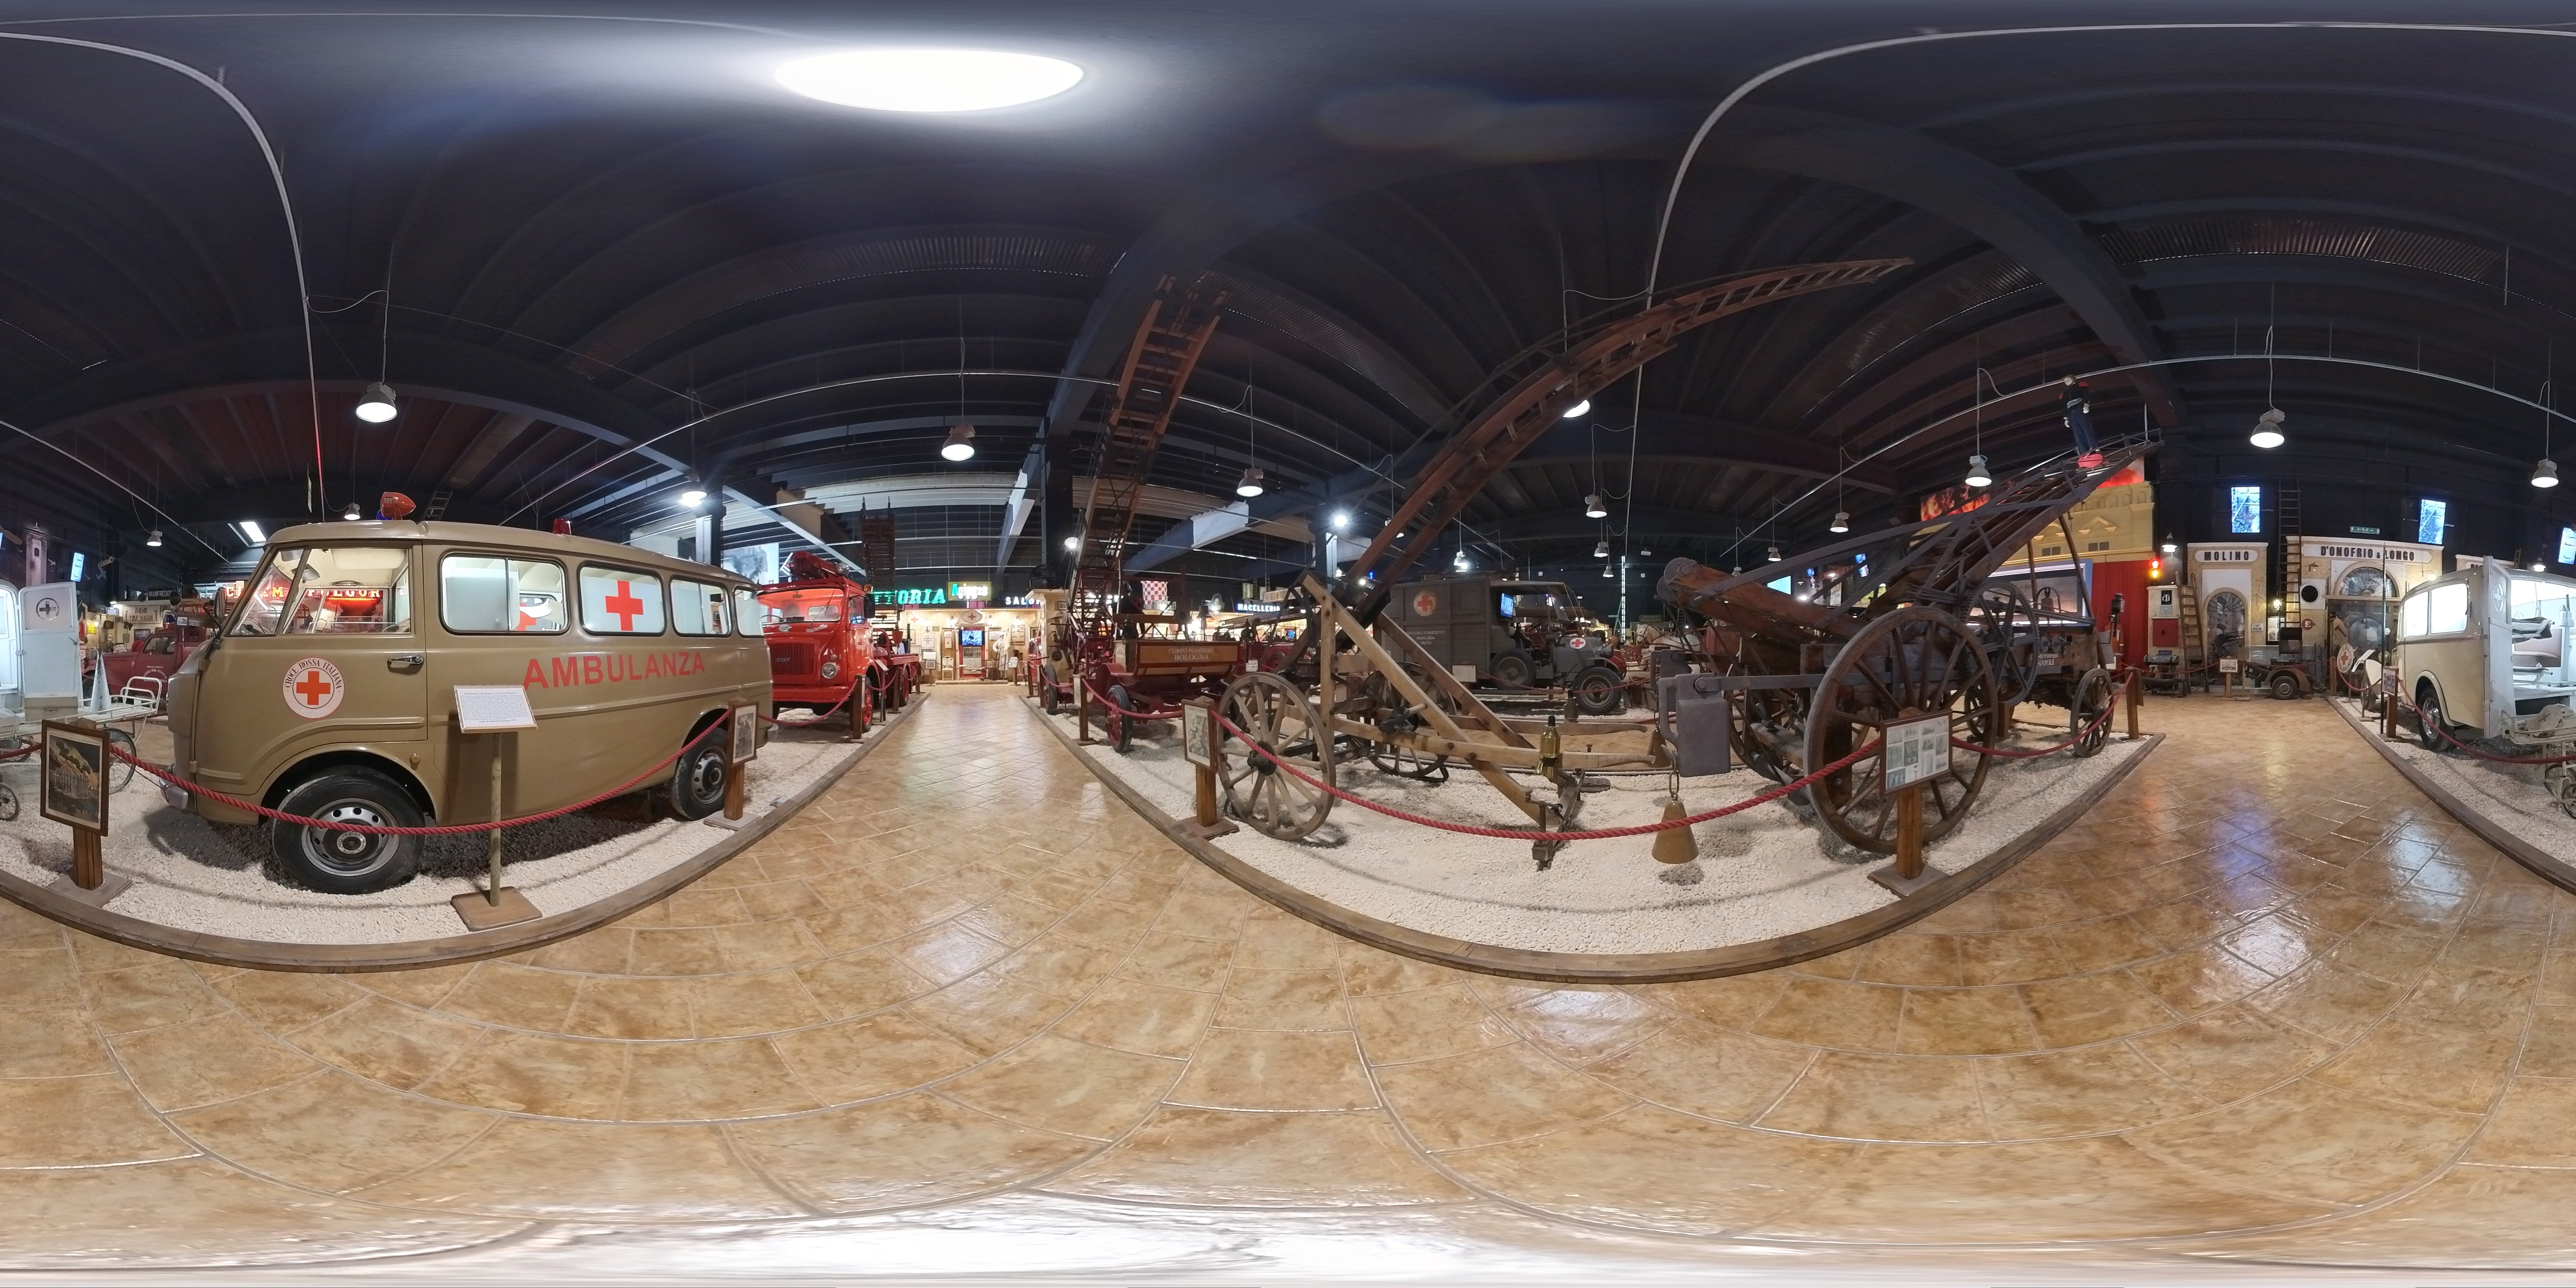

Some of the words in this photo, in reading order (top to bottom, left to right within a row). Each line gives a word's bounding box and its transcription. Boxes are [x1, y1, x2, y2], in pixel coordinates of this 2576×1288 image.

[2204, 551, 2249, 561] MOLINO
[2321, 546, 2373, 558] D'ONOFRIO
[2384, 549, 2414, 561] LONGO
[285, 667, 299, 688] CROCE
[298, 659, 320, 669] ROSSA
[323, 662, 343, 689] ITALIANA
[523, 652, 706, 690] AMBULANZA
